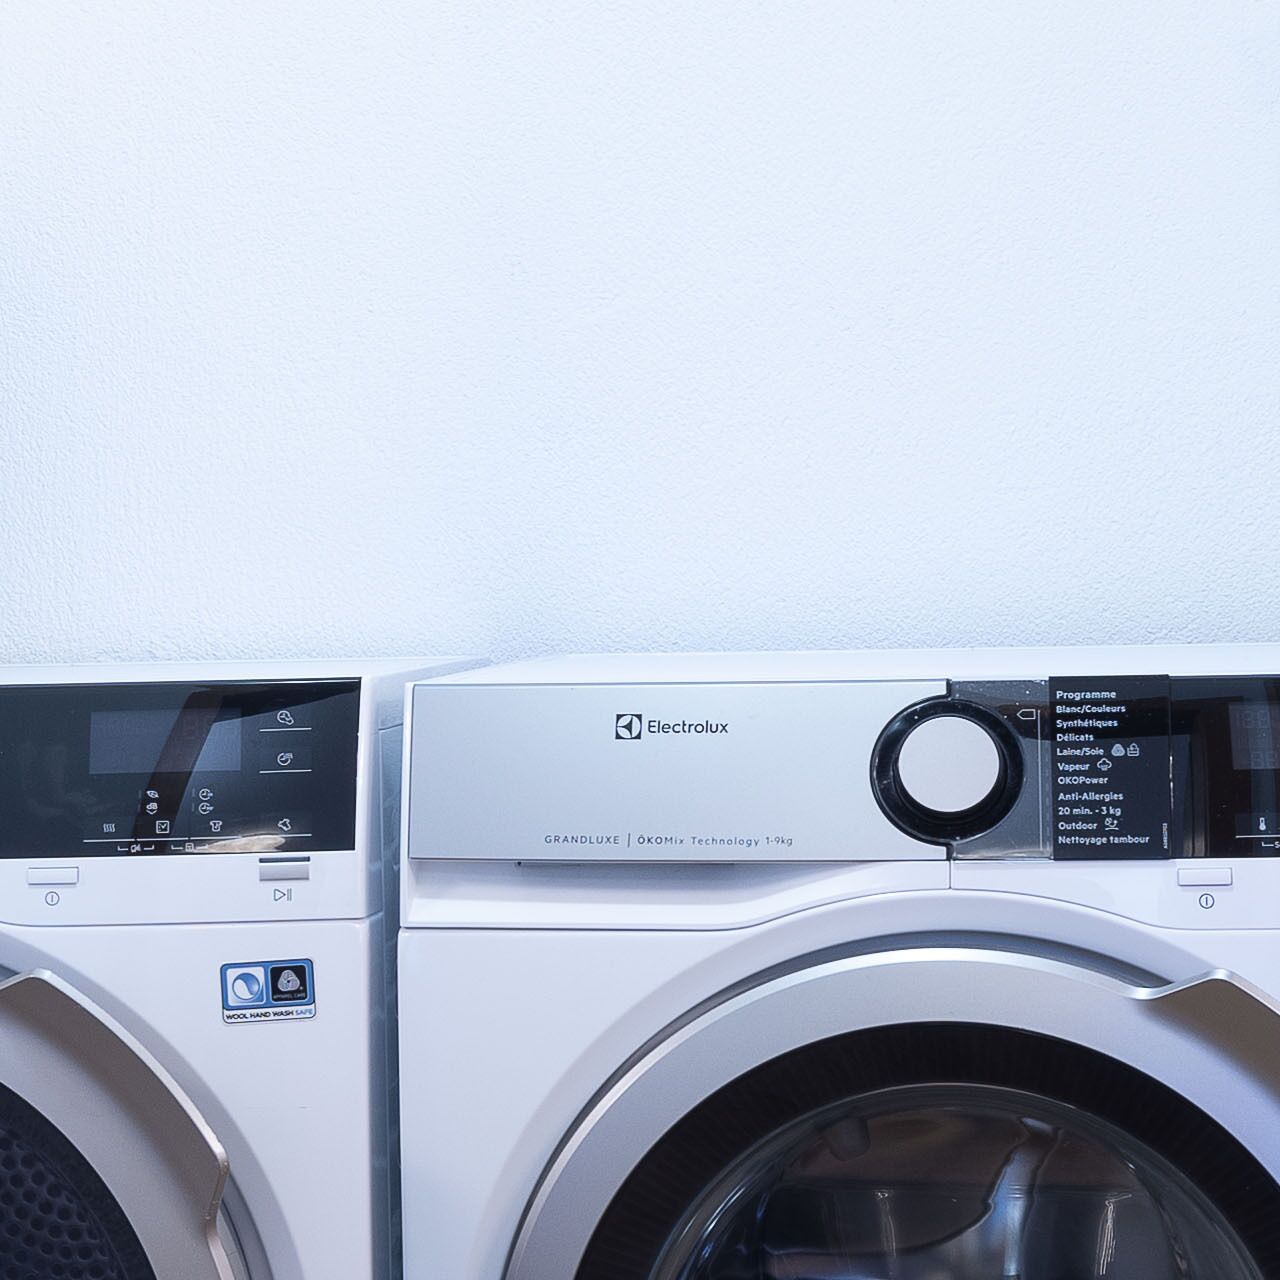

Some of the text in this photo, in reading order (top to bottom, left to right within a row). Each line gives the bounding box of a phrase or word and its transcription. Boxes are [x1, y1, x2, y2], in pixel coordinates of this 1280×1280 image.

[1056, 690, 1117, 701] Programme
[1055, 704, 1126, 714] Blanc/Couleurs
[648, 720, 729, 734] Electrolux
[1056, 719, 1119, 729] Synthétiques
[1056, 733, 1094, 741] Délicats
[1056, 747, 1105, 756] Laine/Soie
[1057, 762, 1090, 772] Vapeur
[1058, 791, 1124, 802] Anti-Allergies
[1058, 807, 1071, 815] 20
[1072, 806, 1093, 815] min.
[1100, 806, 1108, 815] 3
[1109, 805, 1122, 816] kg
[1058, 821, 1098, 830] Outdoor
[544, 835, 620, 845] GRANDLUXE
[691, 836, 760, 847] Technology
[765, 836, 793, 847] 1-9kg
[1058, 834, 1150, 846] Nettoyage tambour
[295, 1008, 313, 1016] SAFE
